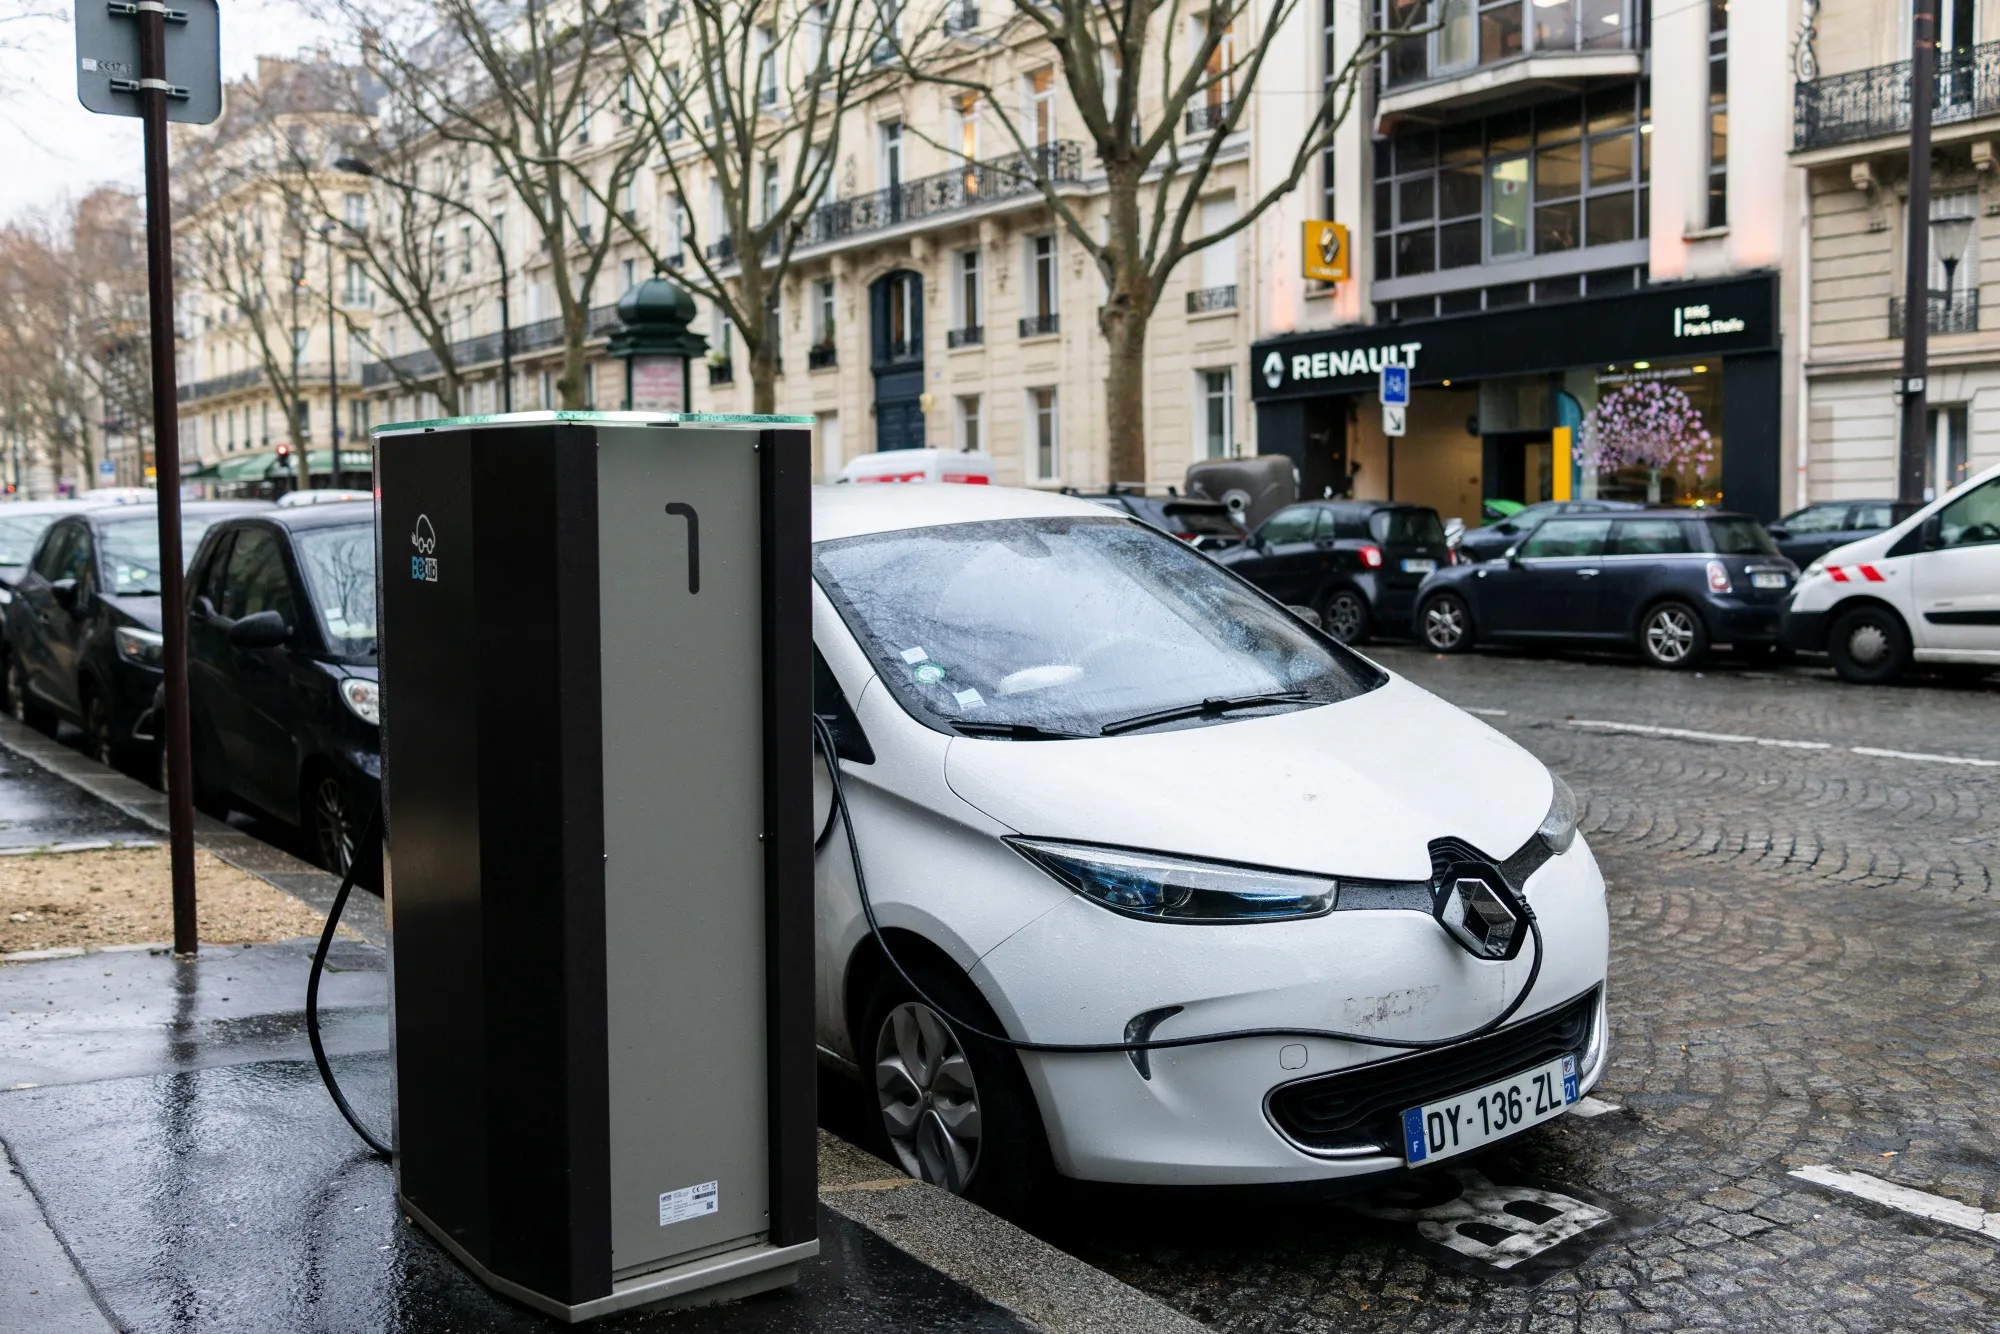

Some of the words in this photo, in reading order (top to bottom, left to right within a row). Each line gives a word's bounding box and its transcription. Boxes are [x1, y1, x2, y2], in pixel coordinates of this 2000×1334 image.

[1683, 321, 1711, 337] Paris
[1291, 342, 1422, 381] RENAULT
[665, 502, 700, 594] 1
[1564, 1080, 1577, 1101] 21
[1426, 1071, 1562, 1154] DY-136-ZL
[1412, 1140, 1420, 1153] F
